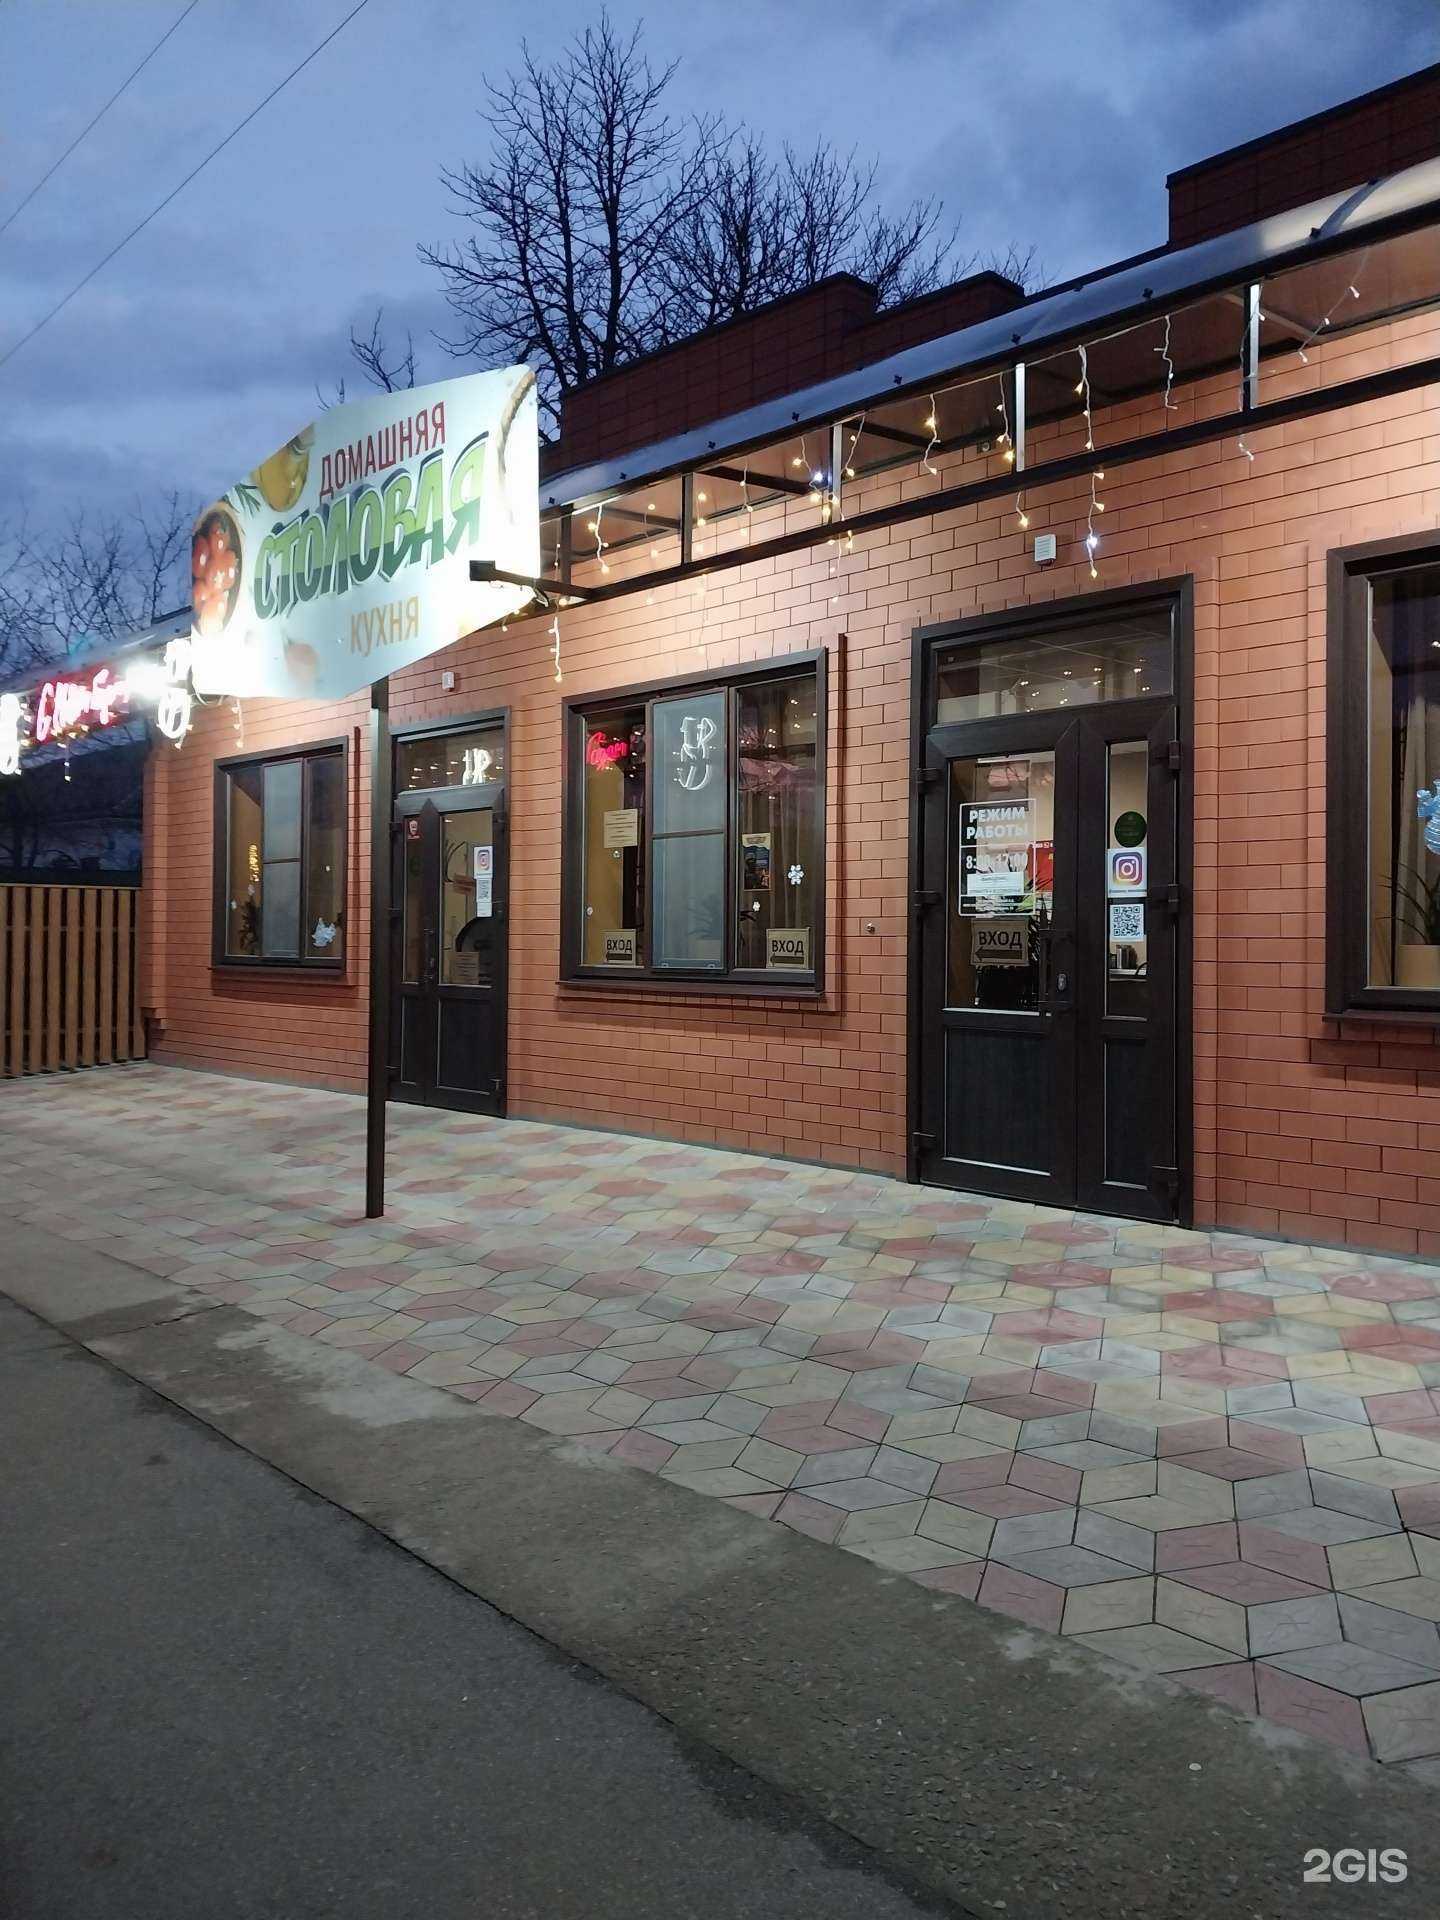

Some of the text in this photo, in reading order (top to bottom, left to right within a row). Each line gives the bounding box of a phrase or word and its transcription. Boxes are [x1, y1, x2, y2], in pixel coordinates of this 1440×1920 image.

[319, 402, 446, 502] ДОМАШНЯЯ
[254, 431, 490, 620] СТОЛОВАЯ
[350, 596, 420, 657] КУХНЯ
[969, 806, 1026, 823] РЕЖИМ
[966, 823, 1029, 840] РАБОТЫ
[606, 939, 633, 953] ВХОД
[771, 938, 805, 954] ВХОД
[978, 931, 1023, 948] ВХОД
